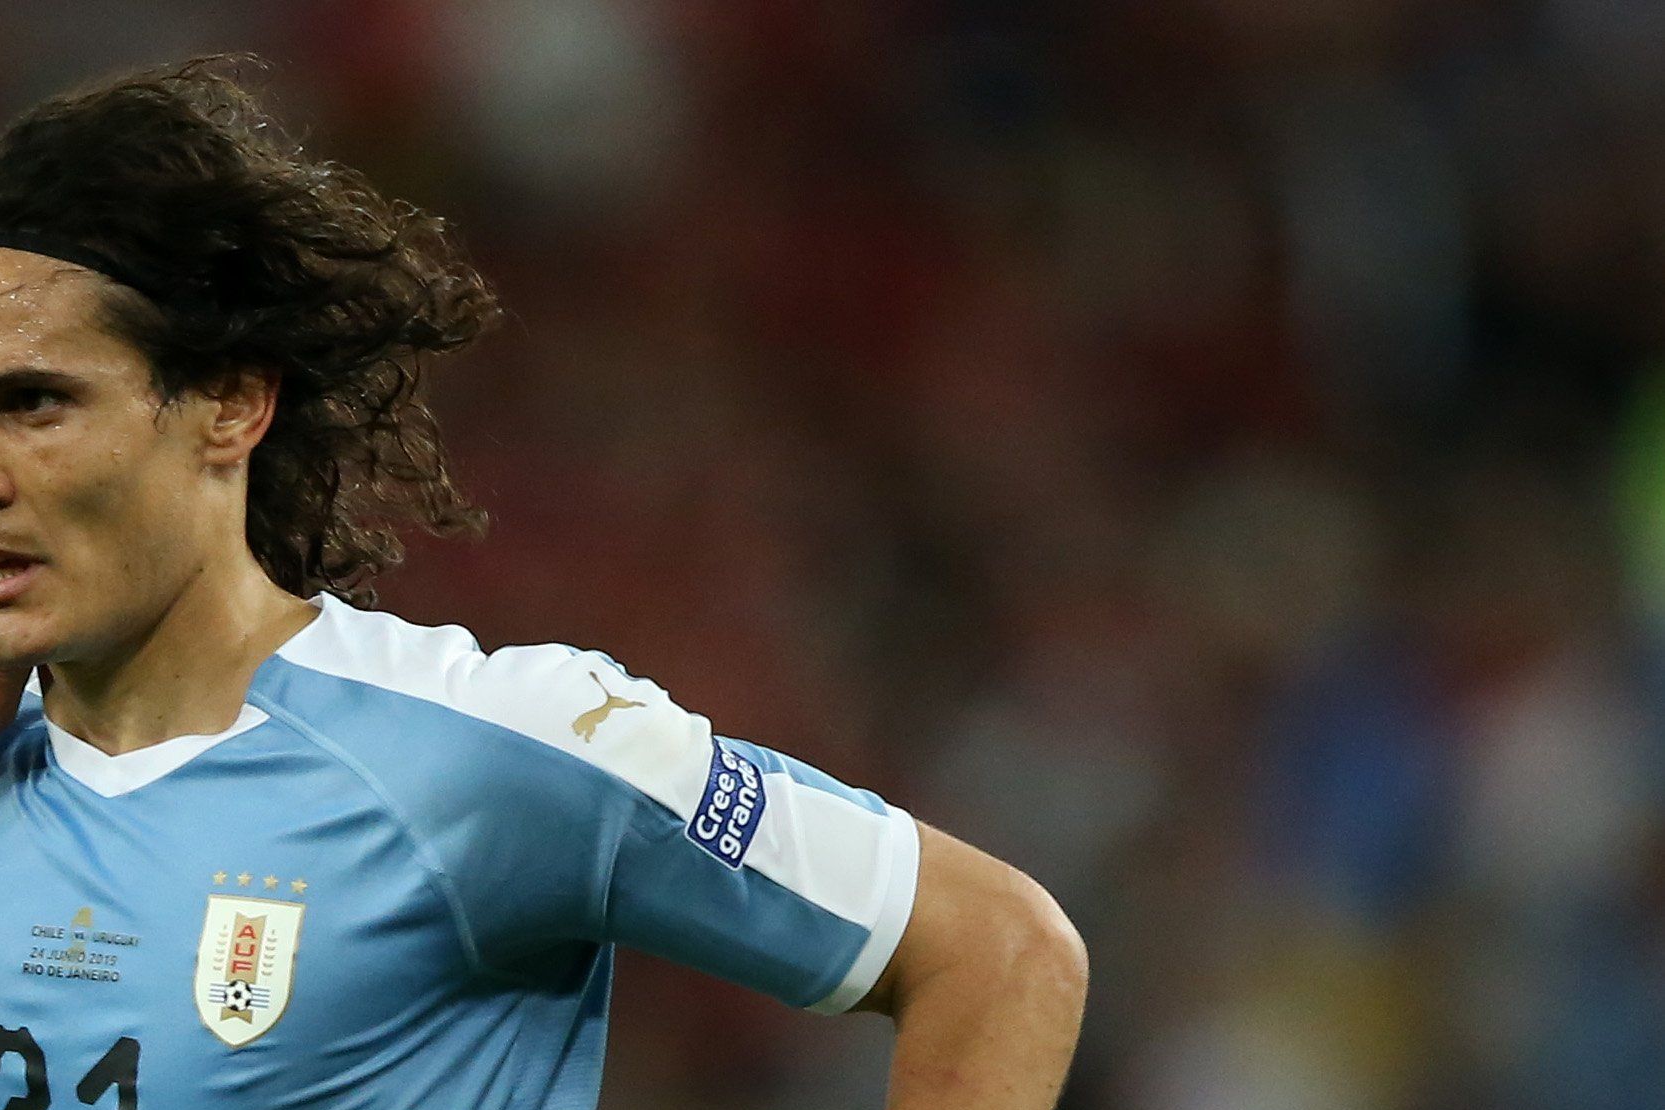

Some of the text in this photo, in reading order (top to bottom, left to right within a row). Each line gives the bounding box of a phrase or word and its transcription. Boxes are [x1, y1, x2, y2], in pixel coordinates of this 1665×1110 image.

[696, 773, 735, 840] Cree
[719, 760, 758, 859] grande
[31, 925, 65, 939] CHILE
[231, 924, 257, 974] AUF
[22, 962, 120, 983] RIO DE JANEIRO
[29, 947, 118, 966] 24 JUNO 2019
